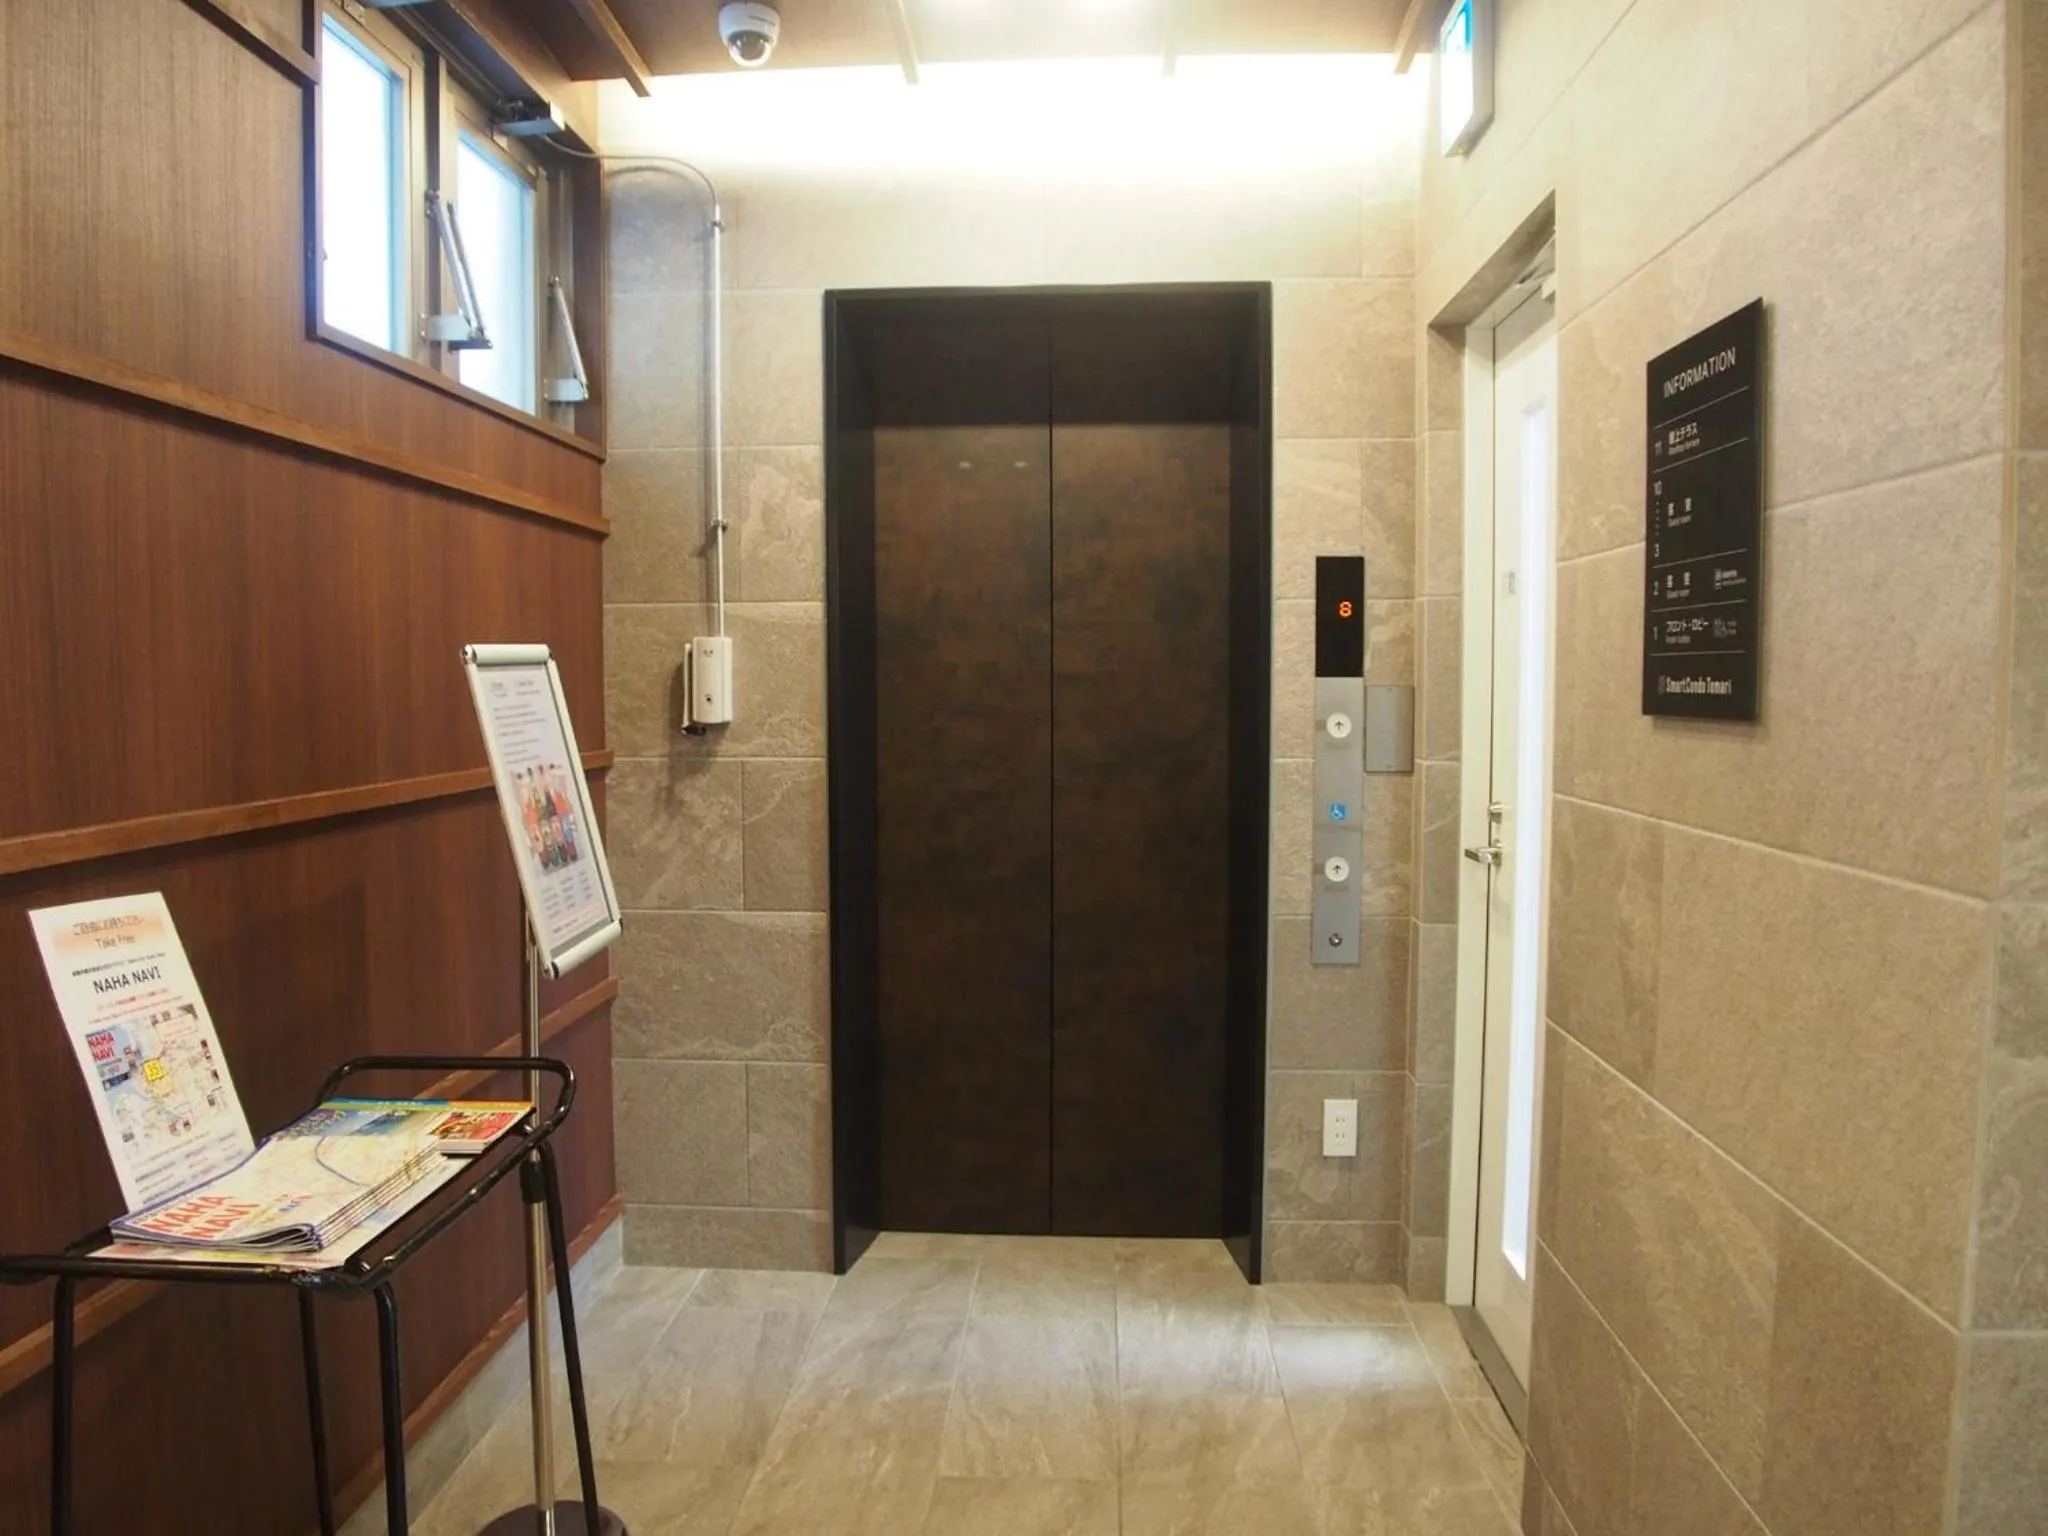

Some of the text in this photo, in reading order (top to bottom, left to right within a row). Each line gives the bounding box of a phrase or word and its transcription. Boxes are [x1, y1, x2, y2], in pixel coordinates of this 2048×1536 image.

[1663, 346, 1736, 399] INFORMATION
[1654, 480, 1662, 496] 10
[1654, 543, 1660, 558] 3
[1653, 581, 1659, 596] 2
[1339, 601, 1352, 617] 8
[1653, 626, 1658, 640] 1
[93, 965, 162, 994] NAHA NAVI
[139, 1196, 235, 1233] NAHA
[180, 1203, 260, 1240] NAVI
